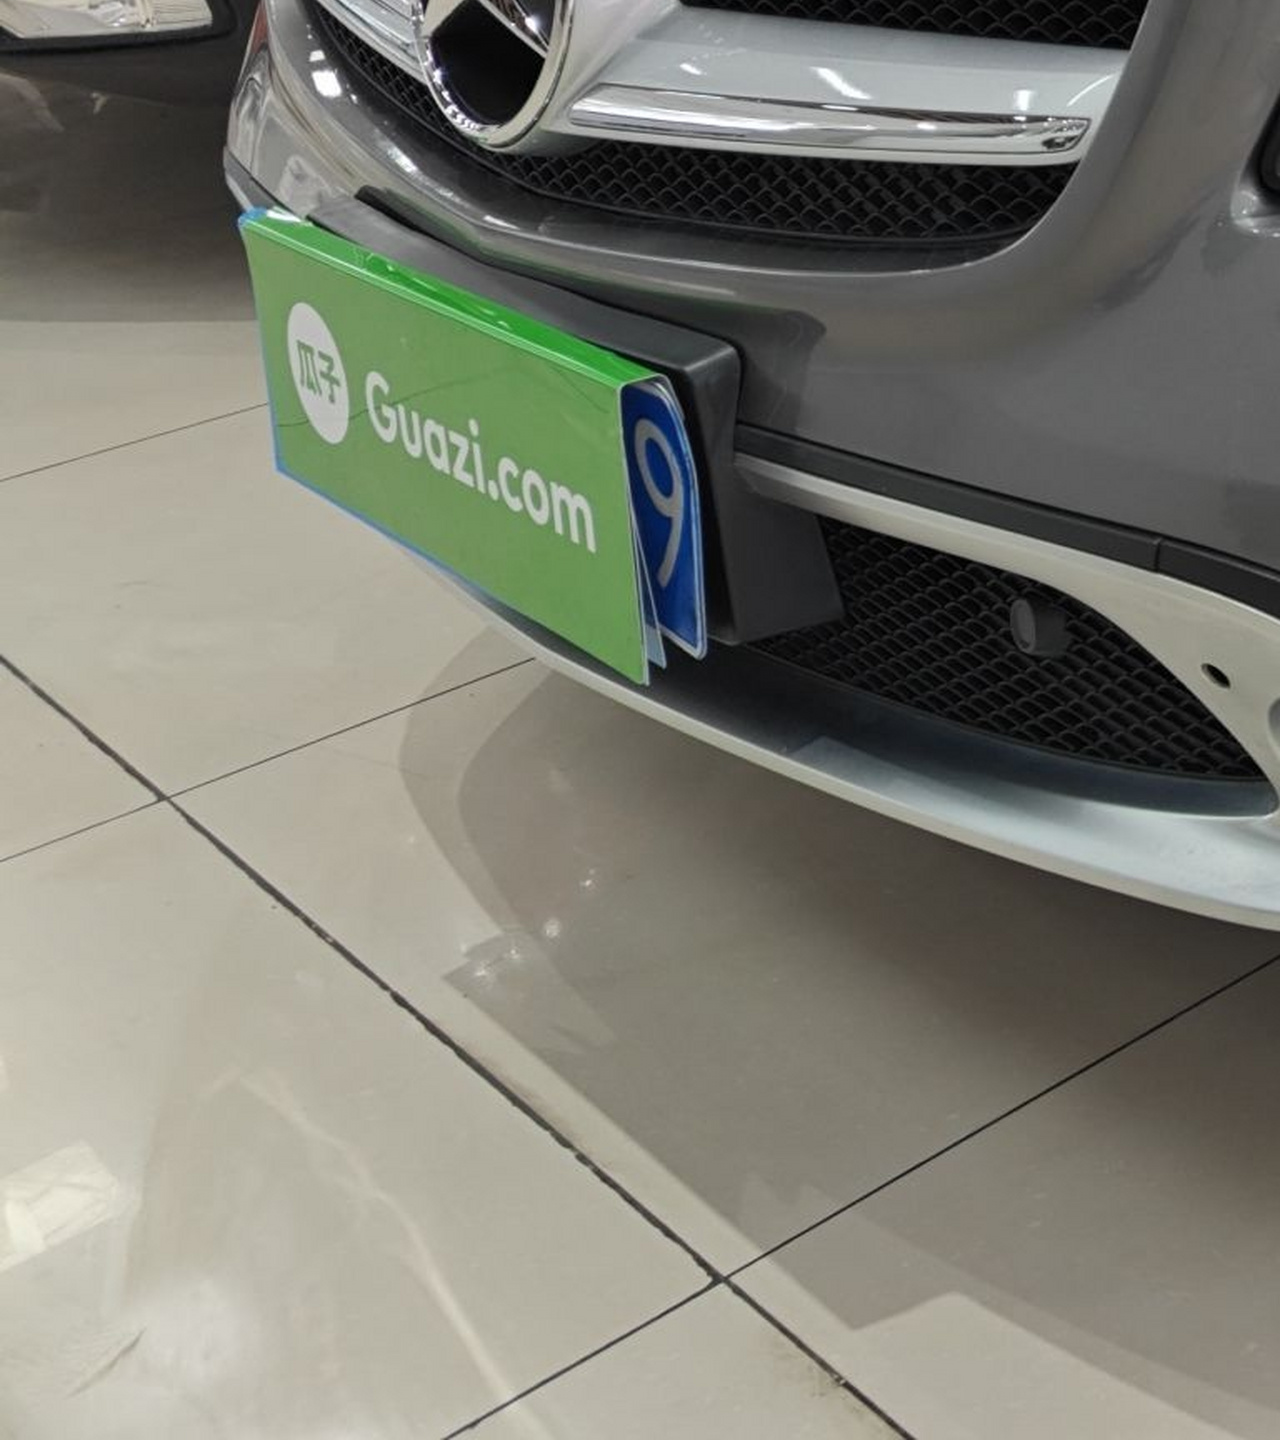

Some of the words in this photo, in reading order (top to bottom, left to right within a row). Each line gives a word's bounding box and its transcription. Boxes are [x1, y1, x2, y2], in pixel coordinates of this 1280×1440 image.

[295, 341, 342, 406] 瓜子
[365, 371, 597, 554] Guazi.com
[633, 418, 685, 588] 9
